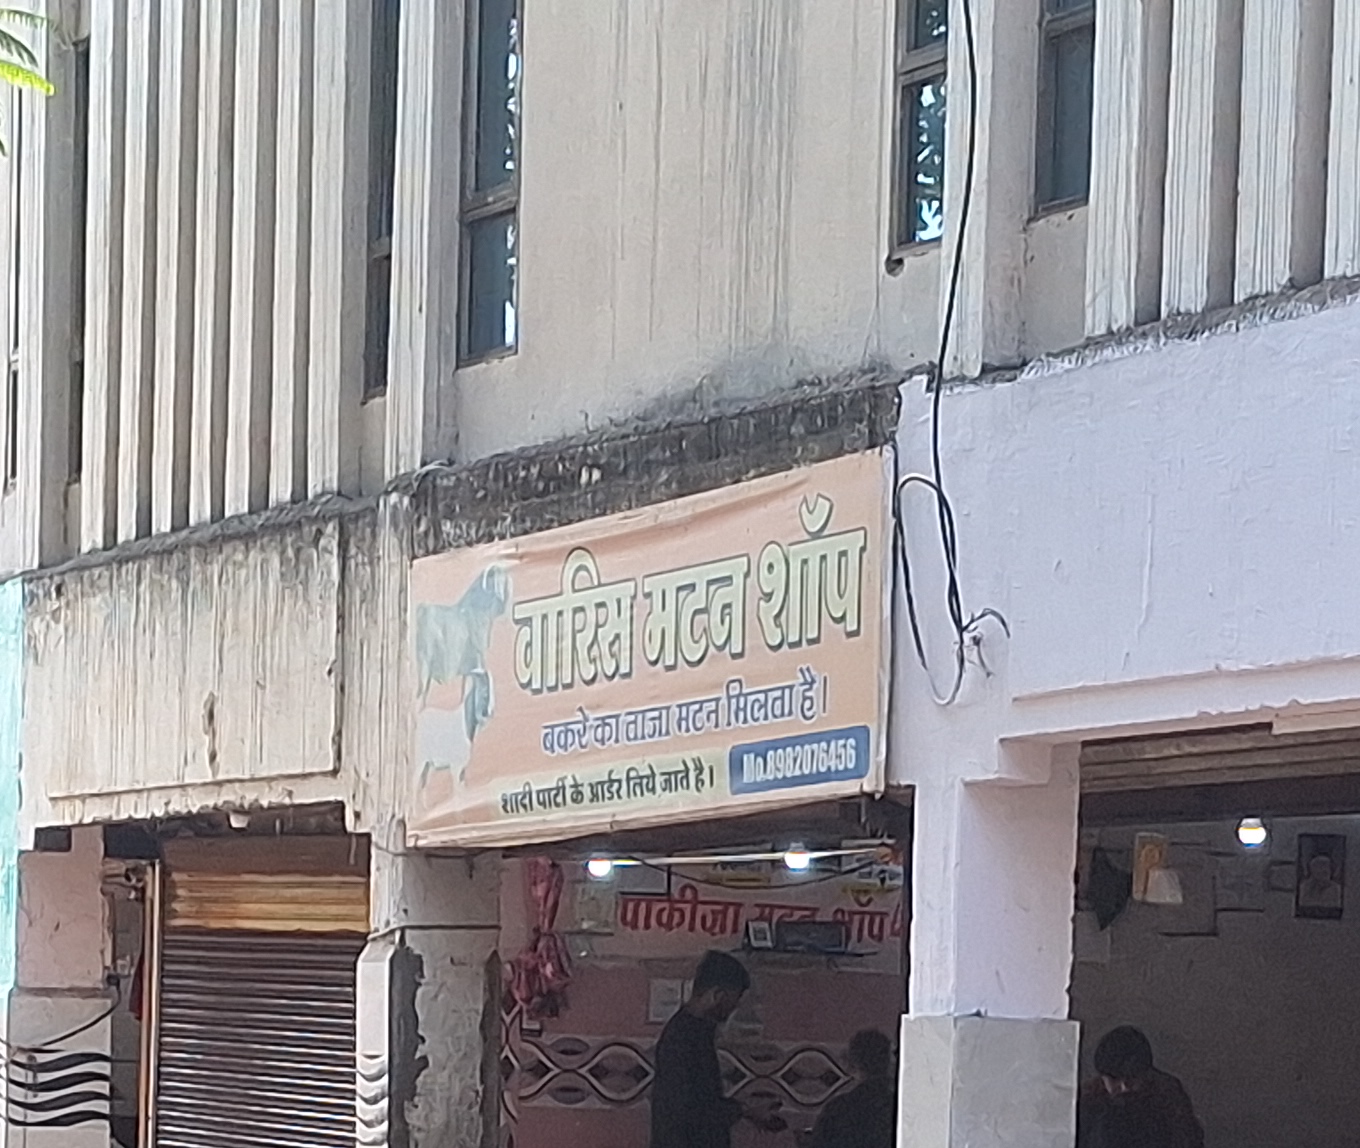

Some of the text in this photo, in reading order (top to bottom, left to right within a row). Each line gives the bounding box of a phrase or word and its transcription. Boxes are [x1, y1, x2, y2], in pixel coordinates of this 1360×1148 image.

[513, 492, 868, 695] वारिस मटन शॉप
[541, 705, 589, 755] बकरे
[589, 713, 621, 747] का
[623, 704, 672, 742] ताजा
[676, 696, 722, 735] मटन
[724, 678, 796, 728] मिलता
[501, 780, 533, 815] शादी
[536, 774, 569, 811] पार्टी
[570, 773, 584, 805] के
[660, 759, 690, 795] जाते
